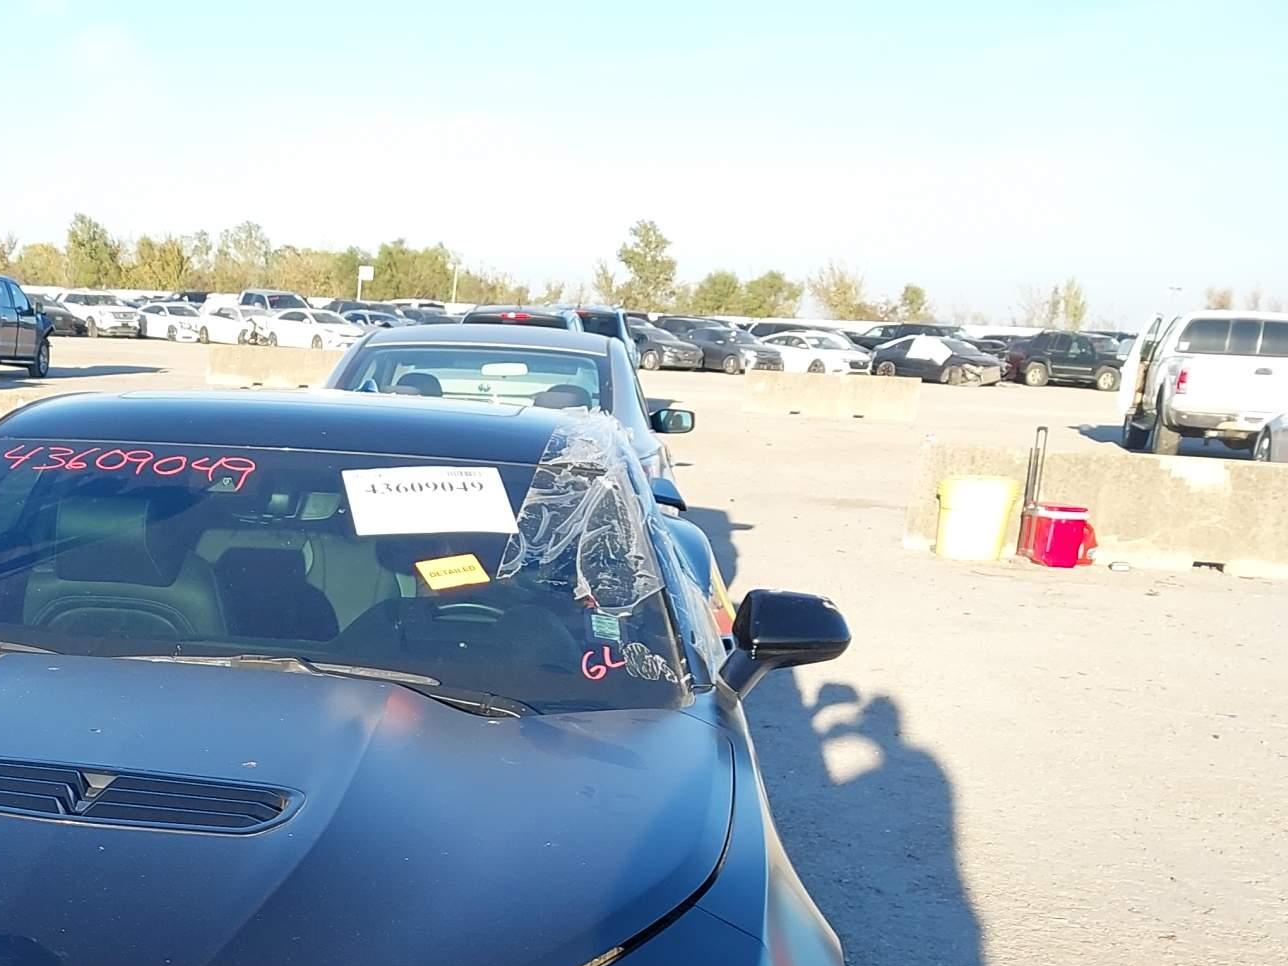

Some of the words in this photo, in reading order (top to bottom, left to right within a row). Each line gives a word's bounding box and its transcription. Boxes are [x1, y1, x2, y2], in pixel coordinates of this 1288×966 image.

[4, 445, 256, 491] 43609049
[365, 480, 484, 495] 43609049
[429, 565, 477, 578] DETAILED
